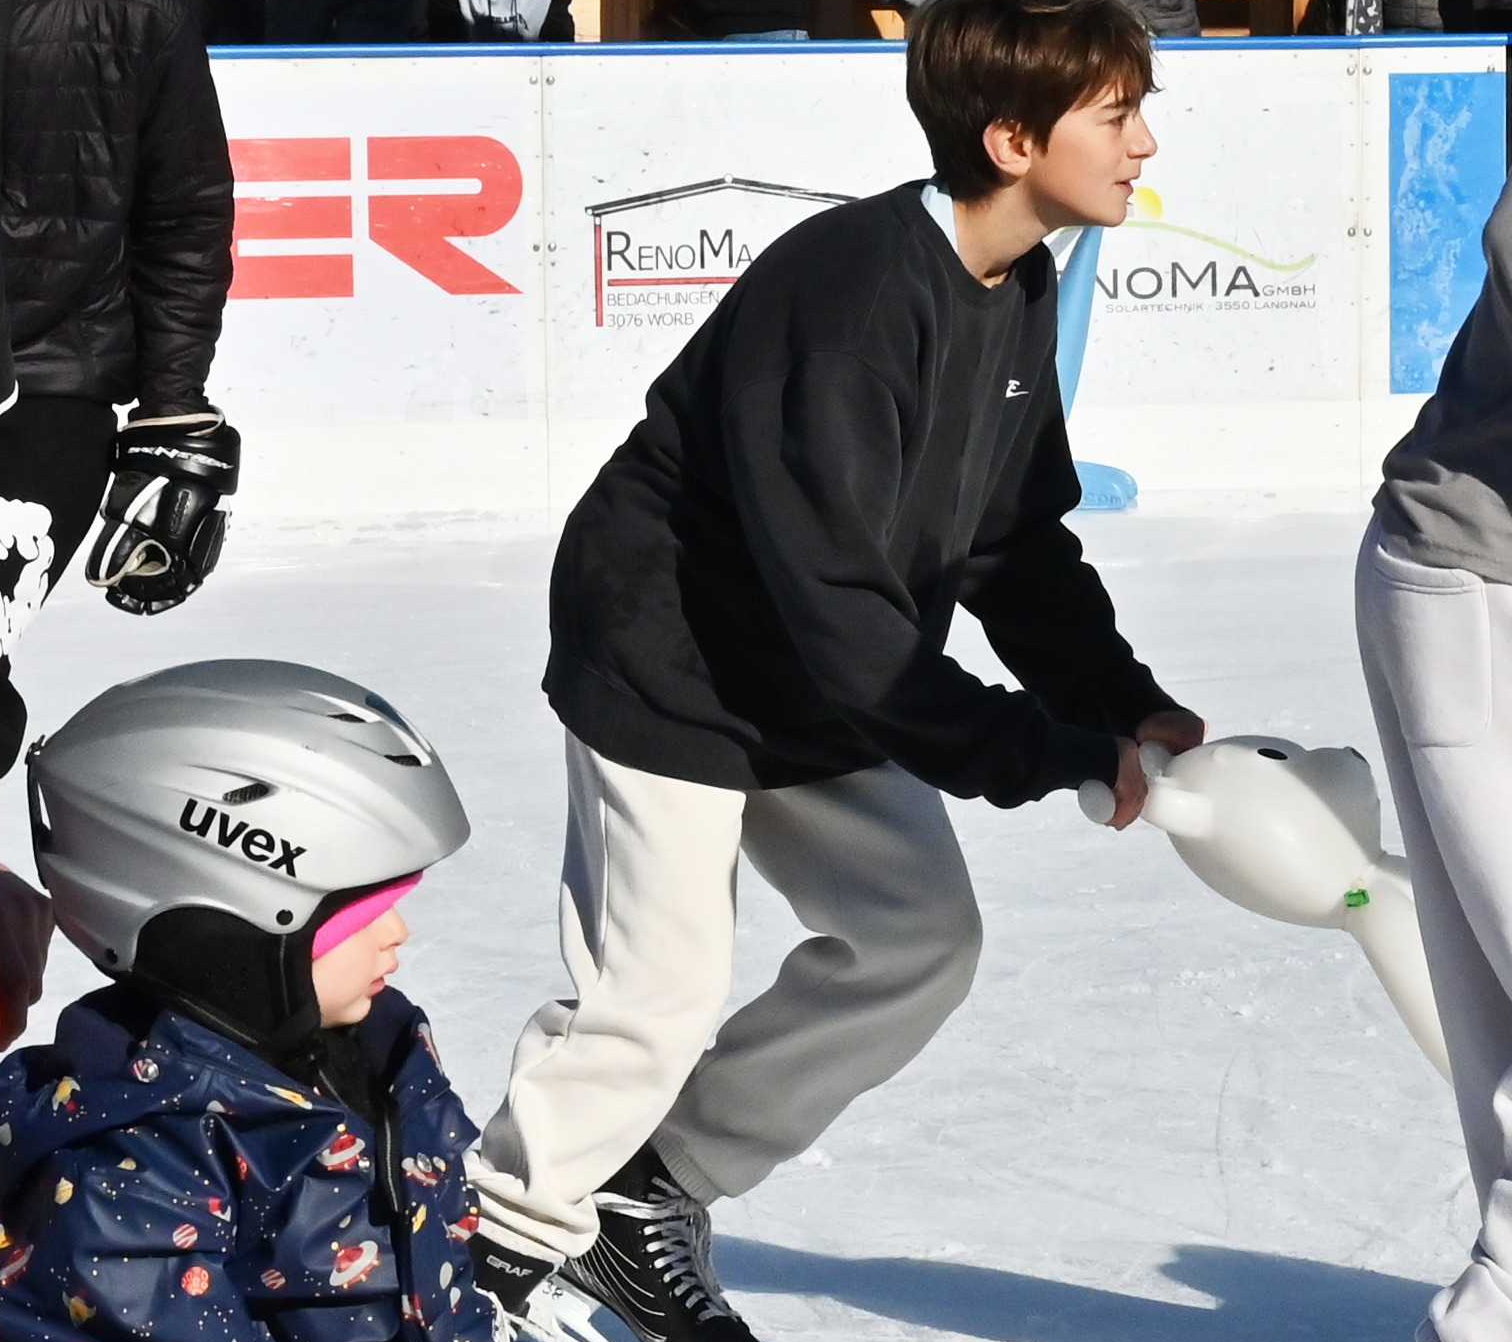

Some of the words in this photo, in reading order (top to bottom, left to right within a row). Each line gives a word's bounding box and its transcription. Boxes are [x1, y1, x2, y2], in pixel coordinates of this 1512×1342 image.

[607, 291, 720, 307] BEDACHUNGEN
[1215, 300, 1251, 311] 3550
[607, 313, 643, 328] 3076
[647, 312, 695, 327] WORB
[178, 797, 307, 879] uvex
[486, 1254, 533, 1278] GRAF
